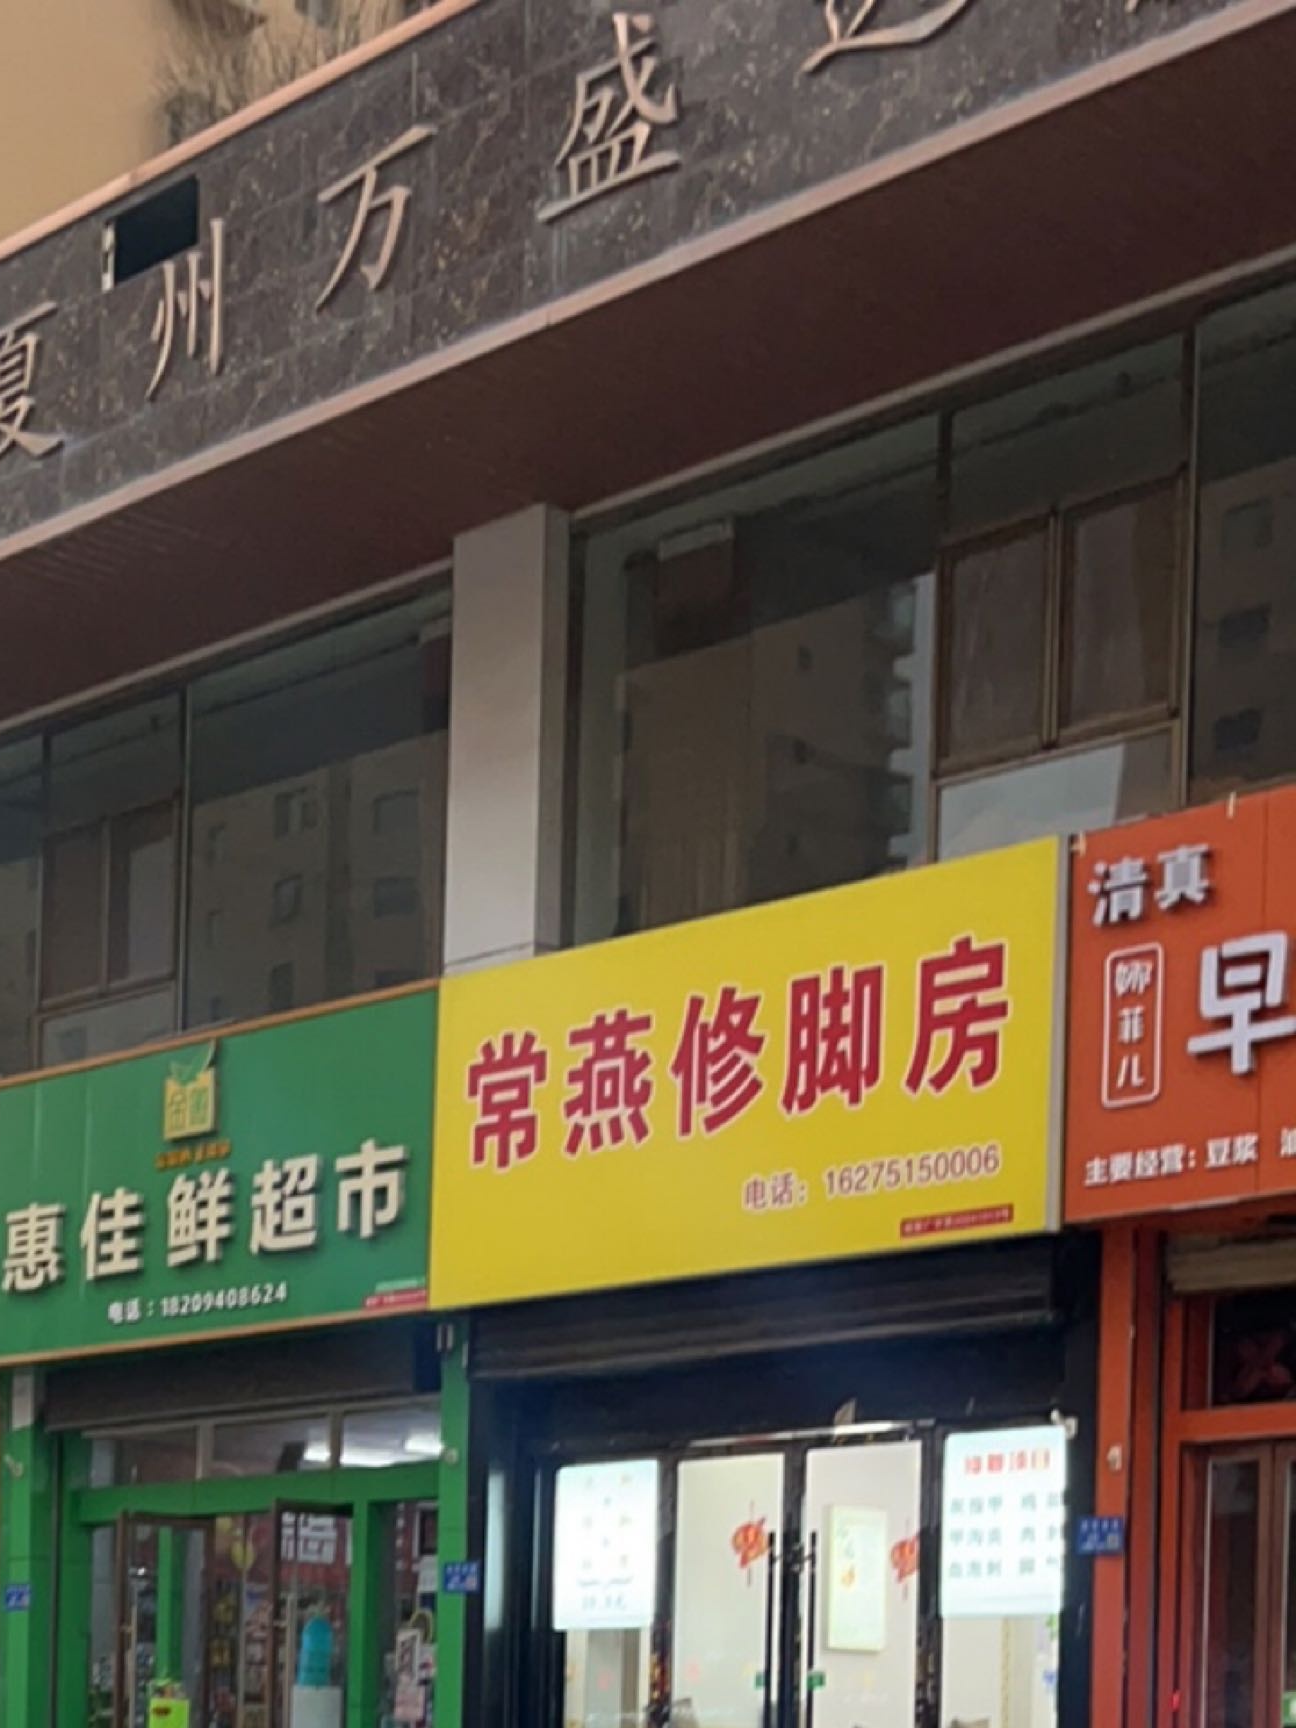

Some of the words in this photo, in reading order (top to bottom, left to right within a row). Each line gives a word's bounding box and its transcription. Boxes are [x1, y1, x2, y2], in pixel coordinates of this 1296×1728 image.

[1087, 844, 1210, 926] 清真
[467, 937, 1009, 1169] 常燕修脚房
[1187, 931, 1296, 1075] 早
[1, 1138, 408, 1292] 惠佳鲜超市
